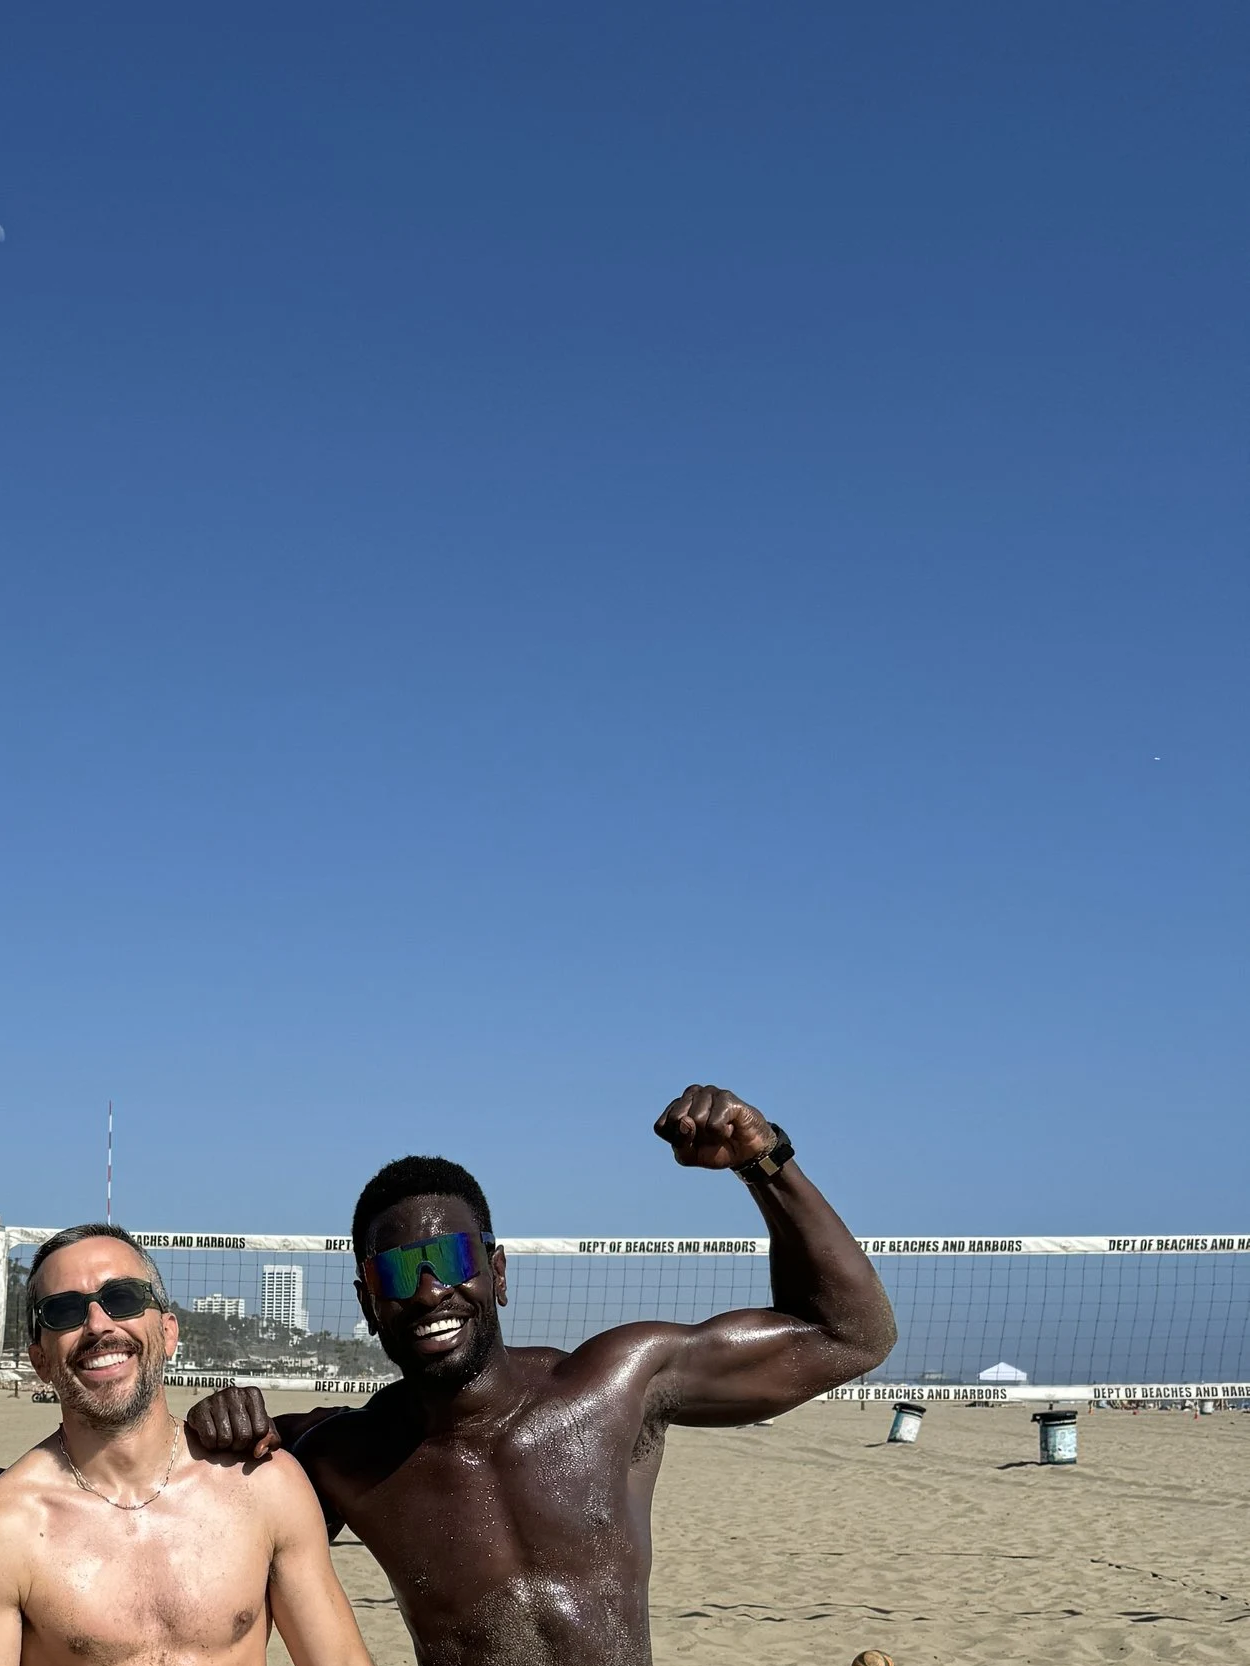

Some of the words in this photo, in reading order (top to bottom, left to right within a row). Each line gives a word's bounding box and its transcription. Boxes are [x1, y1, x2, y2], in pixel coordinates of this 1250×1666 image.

[132, 1234, 170, 1247] ACHES
[172, 1236, 194, 1248] AND
[196, 1236, 246, 1249] HARBORS
[325, 1239, 351, 1251] DEPT
[579, 1241, 605, 1253] DEPT
[609, 1241, 622, 1253] OF
[625, 1241, 675, 1253] BEACHES
[677, 1241, 700, 1253] AND
[703, 1240, 757, 1252] HARBORS
[872, 1240, 886, 1252] OF
[889, 1240, 939, 1252] BEACHES
[942, 1240, 965, 1252] AND
[968, 1240, 1022, 1252] HARBORS
[1108, 1239, 1137, 1251] DEPT
[1140, 1239, 1154, 1251] OF
[1157, 1239, 1207, 1251] BEACHES
[1210, 1238, 1234, 1250] AND
[163, 1376, 184, 1387] AND
[187, 1376, 236, 1388] HARBORS
[315, 1380, 341, 1392] DEPT
[344, 1381, 356, 1392] OF
[359, 1382, 390, 1393] BEAC
[827, 1388, 854, 1400] DEPT
[857, 1388, 871, 1400] OF
[874, 1388, 924, 1400] BEACHES
[927, 1388, 950, 1400] AND
[953, 1388, 1007, 1400] HARBORS
[1093, 1387, 1121, 1399] DEPT
[1125, 1387, 1138, 1398] OF
[1142, 1386, 1192, 1398] BEACHES
[1195, 1386, 1219, 1397] AND
